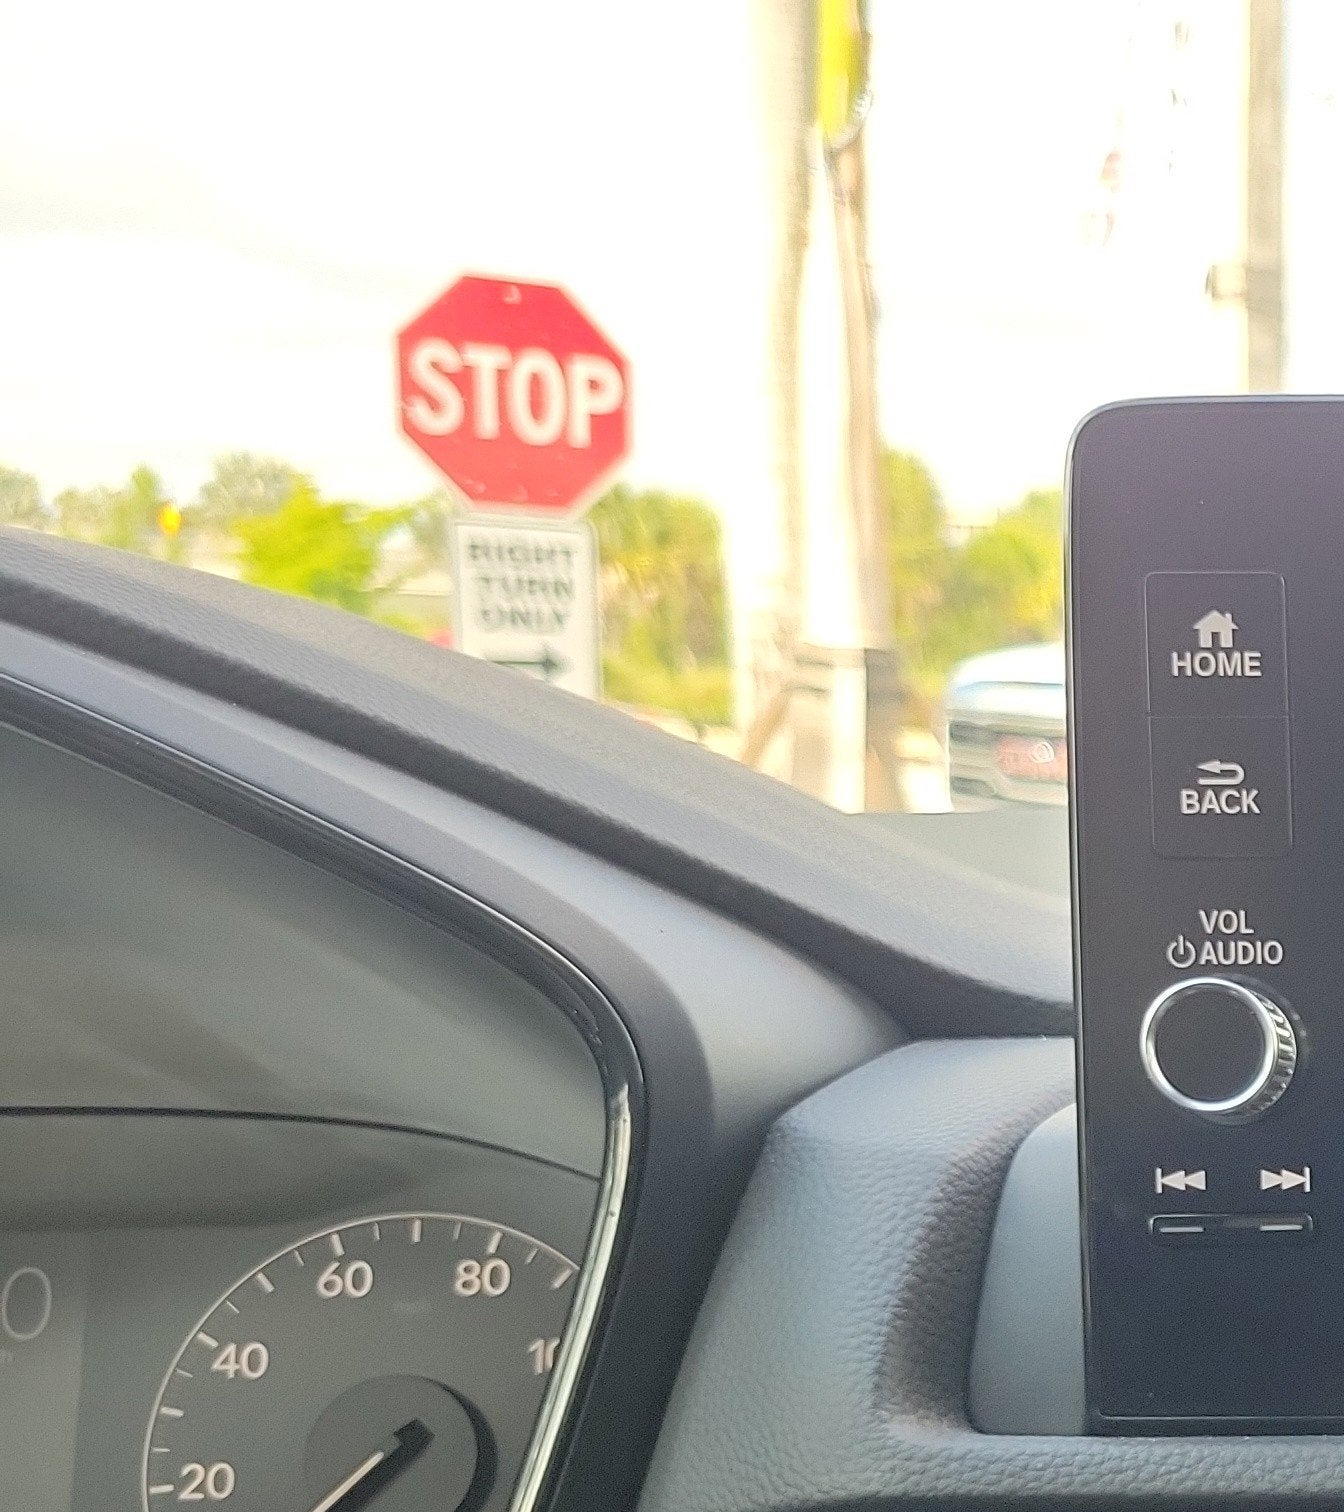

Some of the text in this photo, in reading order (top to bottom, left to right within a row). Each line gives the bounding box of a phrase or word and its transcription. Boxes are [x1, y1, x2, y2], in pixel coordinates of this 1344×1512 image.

[404, 338, 624, 448] STOP
[1170, 650, 1263, 679] HOME
[1179, 790, 1261, 816] BACK
[1199, 909, 1255, 935] VOL
[1199, 939, 1284, 966] AUDIO
[316, 1260, 374, 1298] 60
[454, 1260, 511, 1298] 80
[211, 1341, 269, 1379] 40
[178, 1462, 235, 1501] 20
